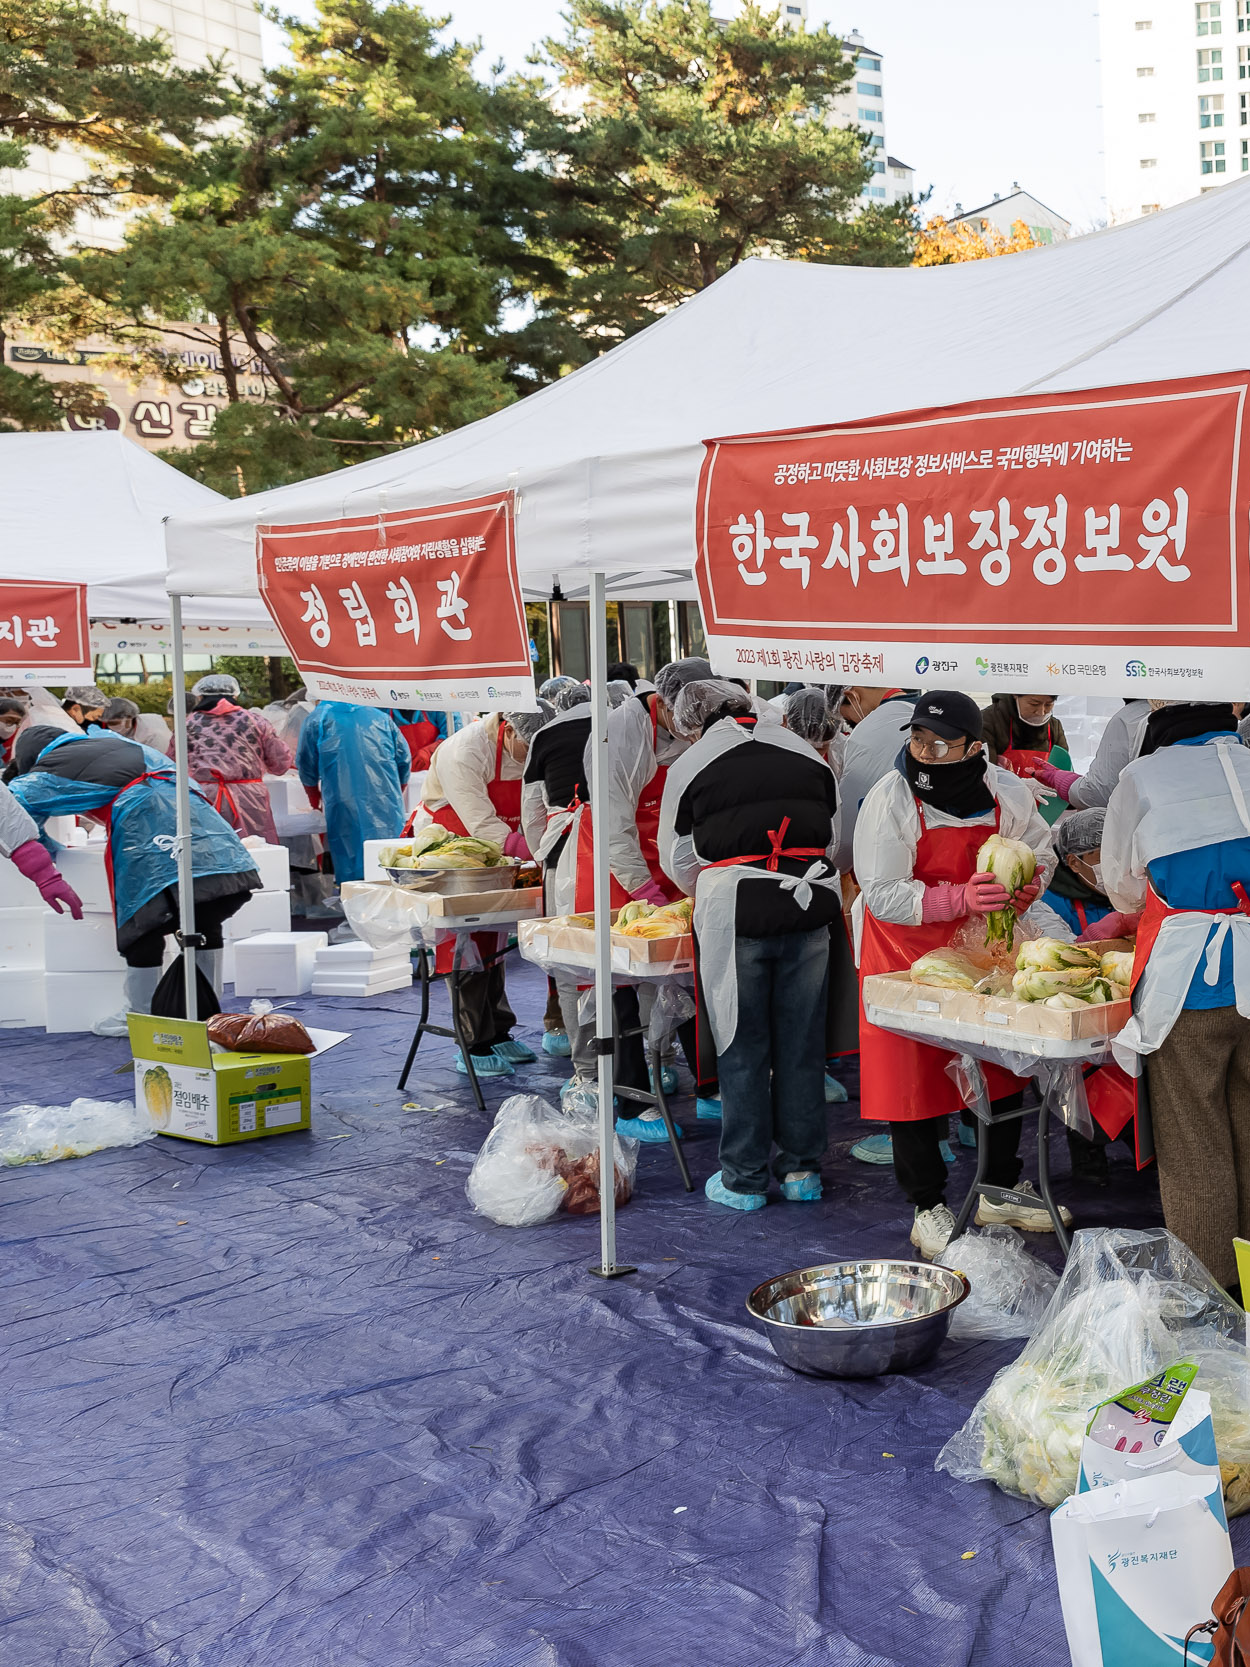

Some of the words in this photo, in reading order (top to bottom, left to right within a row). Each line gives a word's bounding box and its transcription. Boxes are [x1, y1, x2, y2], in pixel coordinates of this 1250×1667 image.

[774, 462, 822, 485] 공정하고
[823, 459, 860, 482] 따뜻한
[862, 455, 913, 481] 사회보장
[914, 449, 994, 477] 정보서비스로
[996, 441, 1069, 471] 국민행복에
[1071, 437, 1133, 465] 기여하는
[728, 487, 1192, 588] 한국사회보장정보원
[736, 648, 756, 663] 2023
[757, 649, 780, 667] 제1회
[782, 650, 803, 670] 광진
[805, 651, 837, 672] 사랑의
[838, 652, 884, 673] 김장축제
[932, 660, 959, 672] 광진구
[990, 662, 1029, 674] 광진복지재단
[1148, 667, 1204, 679] 한국사회보장정보원
[174, 1090, 211, 1111] 절임배추
[1121, 1549, 1178, 1568] 광진복지재단
